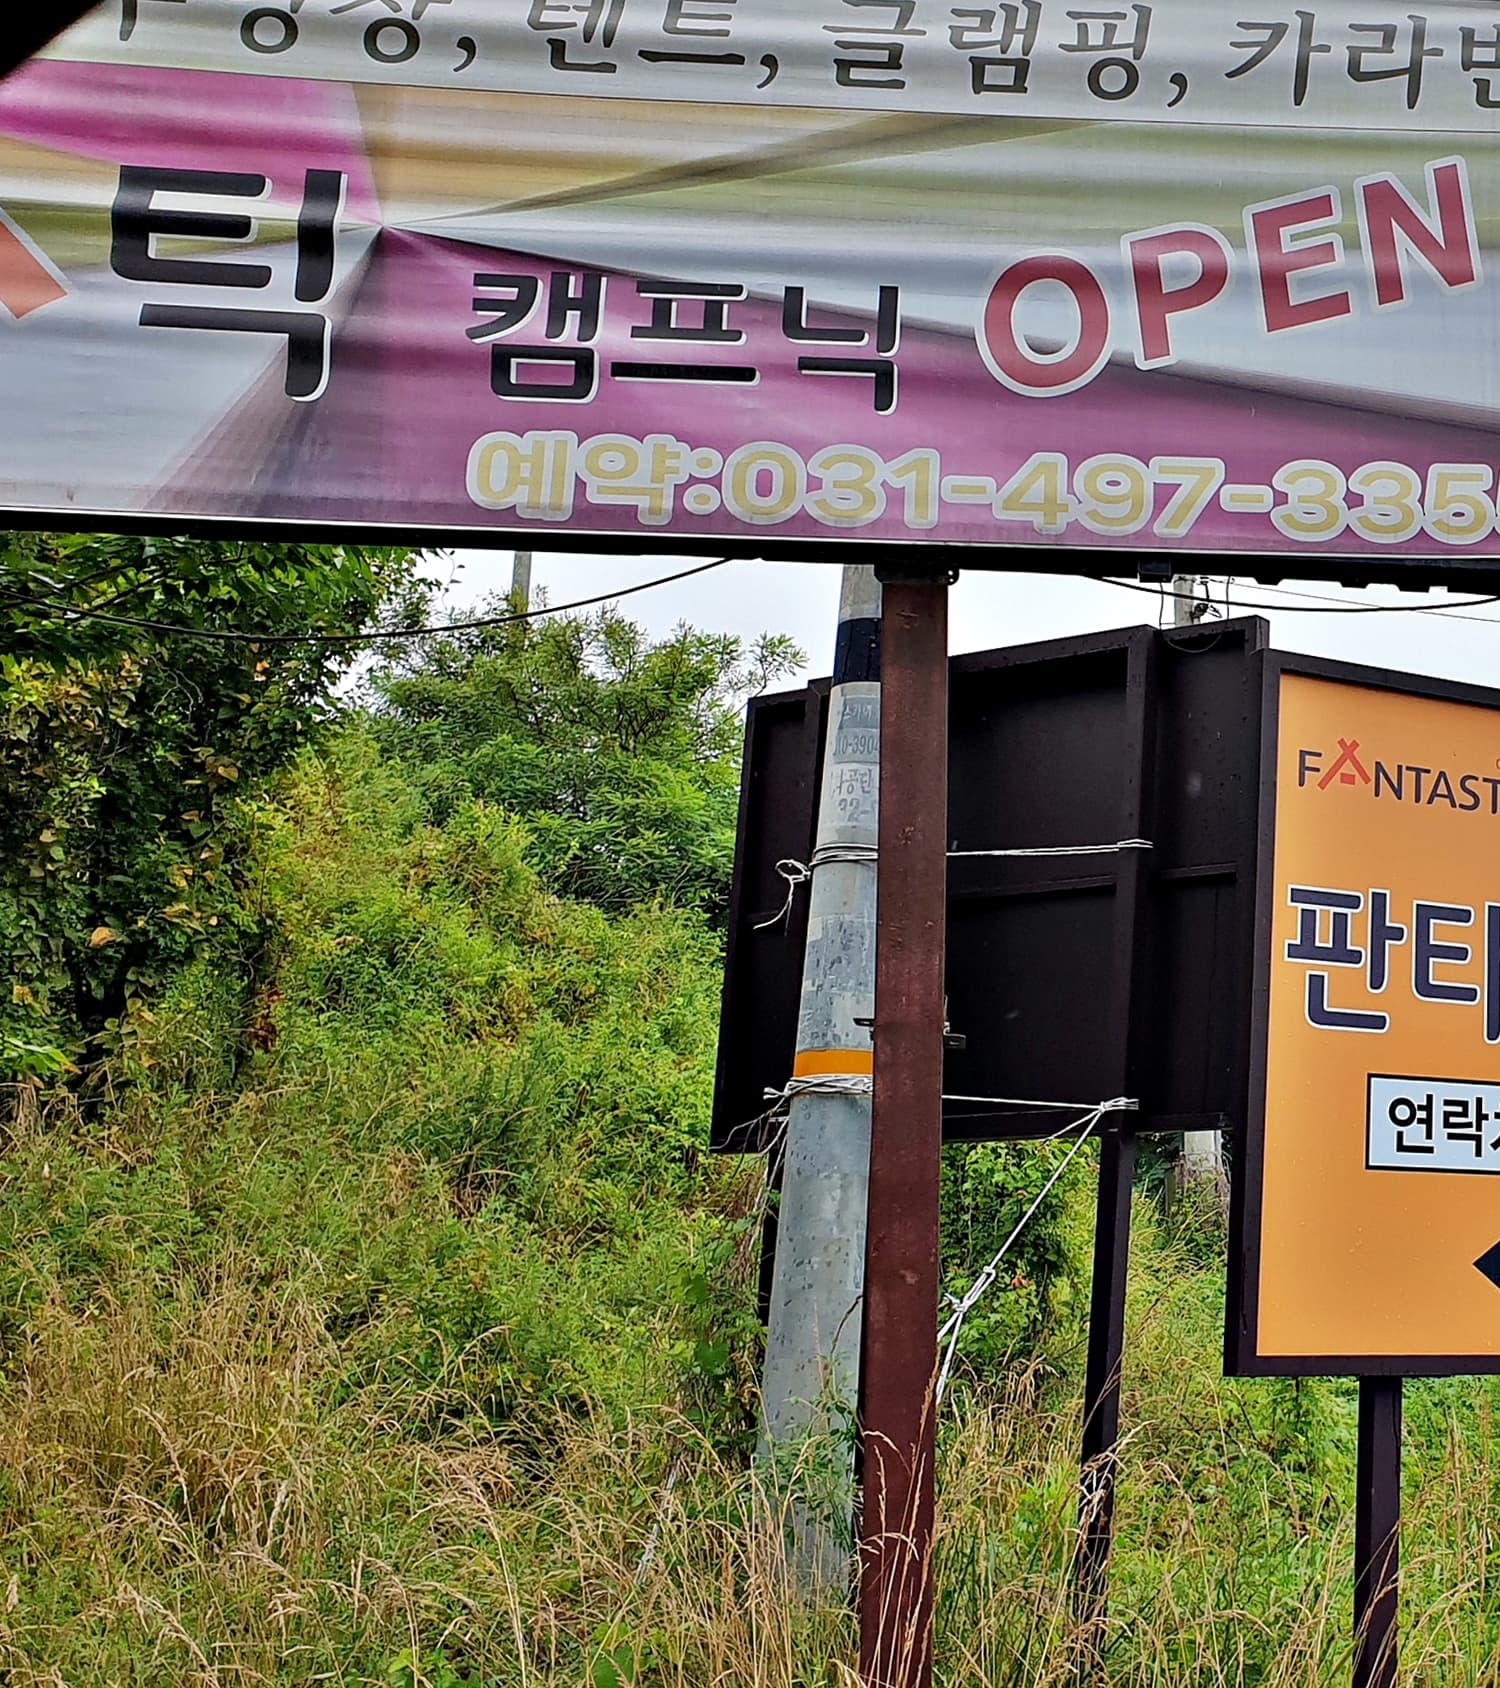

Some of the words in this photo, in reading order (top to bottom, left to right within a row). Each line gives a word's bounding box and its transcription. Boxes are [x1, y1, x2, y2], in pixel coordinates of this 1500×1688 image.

[526, 0, 779, 89] 텐트,
[822, 0, 1189, 109] 글램핑,
[466, 271, 900, 415] 캠프닉
[976, 156, 1480, 395] OPEN
